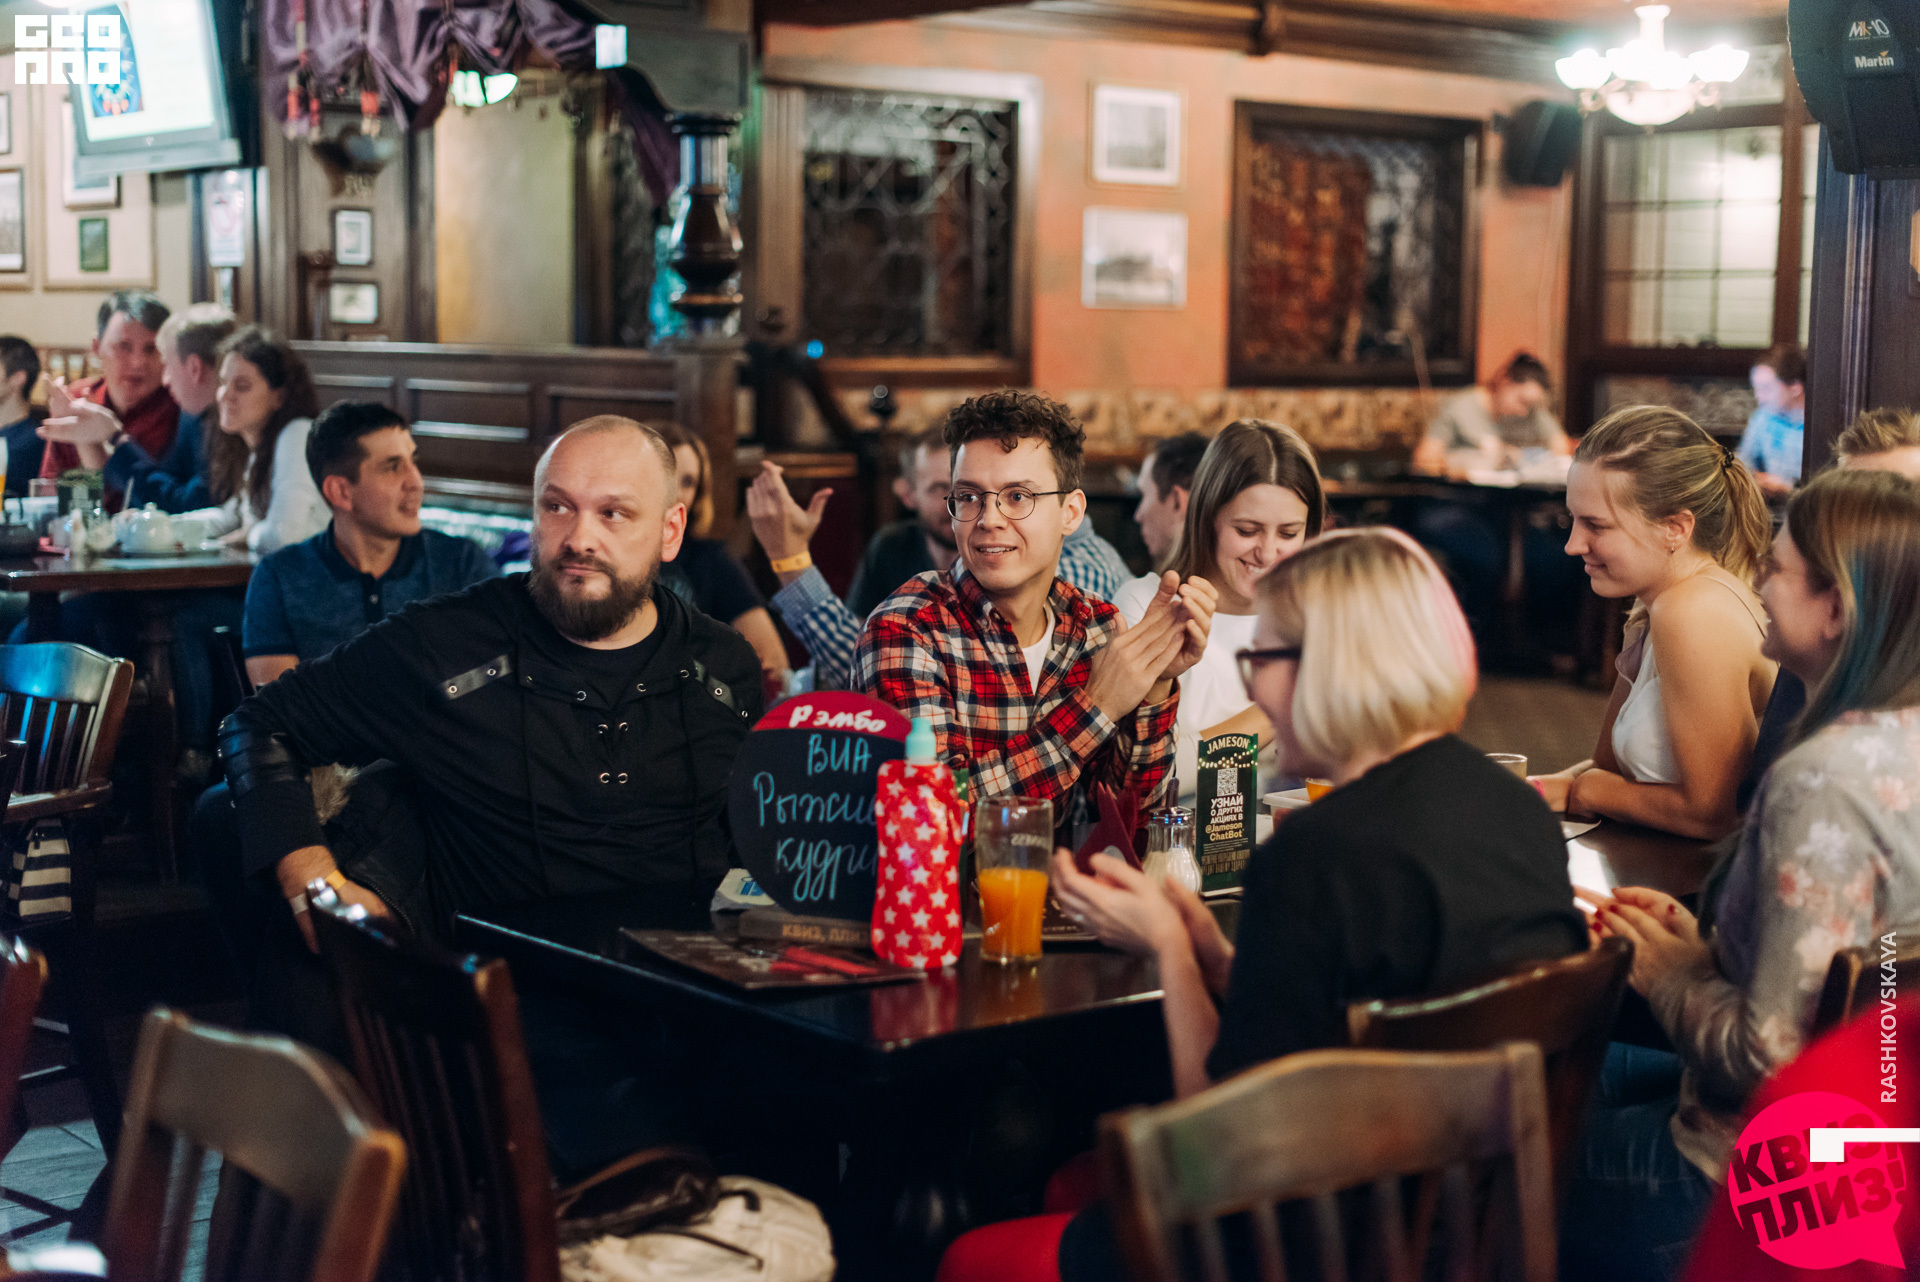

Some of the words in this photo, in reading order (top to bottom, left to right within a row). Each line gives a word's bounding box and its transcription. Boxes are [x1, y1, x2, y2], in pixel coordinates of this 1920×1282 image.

[1855, 54, 1894, 68] Martin
[789, 705, 887, 732] Рэмбо
[1207, 736, 1250, 755] JAMESON
[807, 733, 872, 776] ВИА
[1210, 792, 1244, 809] УЗНАЙ
[1210, 808, 1217, 817] О
[1217, 805, 1244, 817] ДРУГИХ
[1210, 814, 1237, 825] АКЦИЯХ
[1238, 813, 1244, 821] В
[1205, 822, 1243, 834] @Jameson
[1210, 830, 1243, 842] ChatBot
